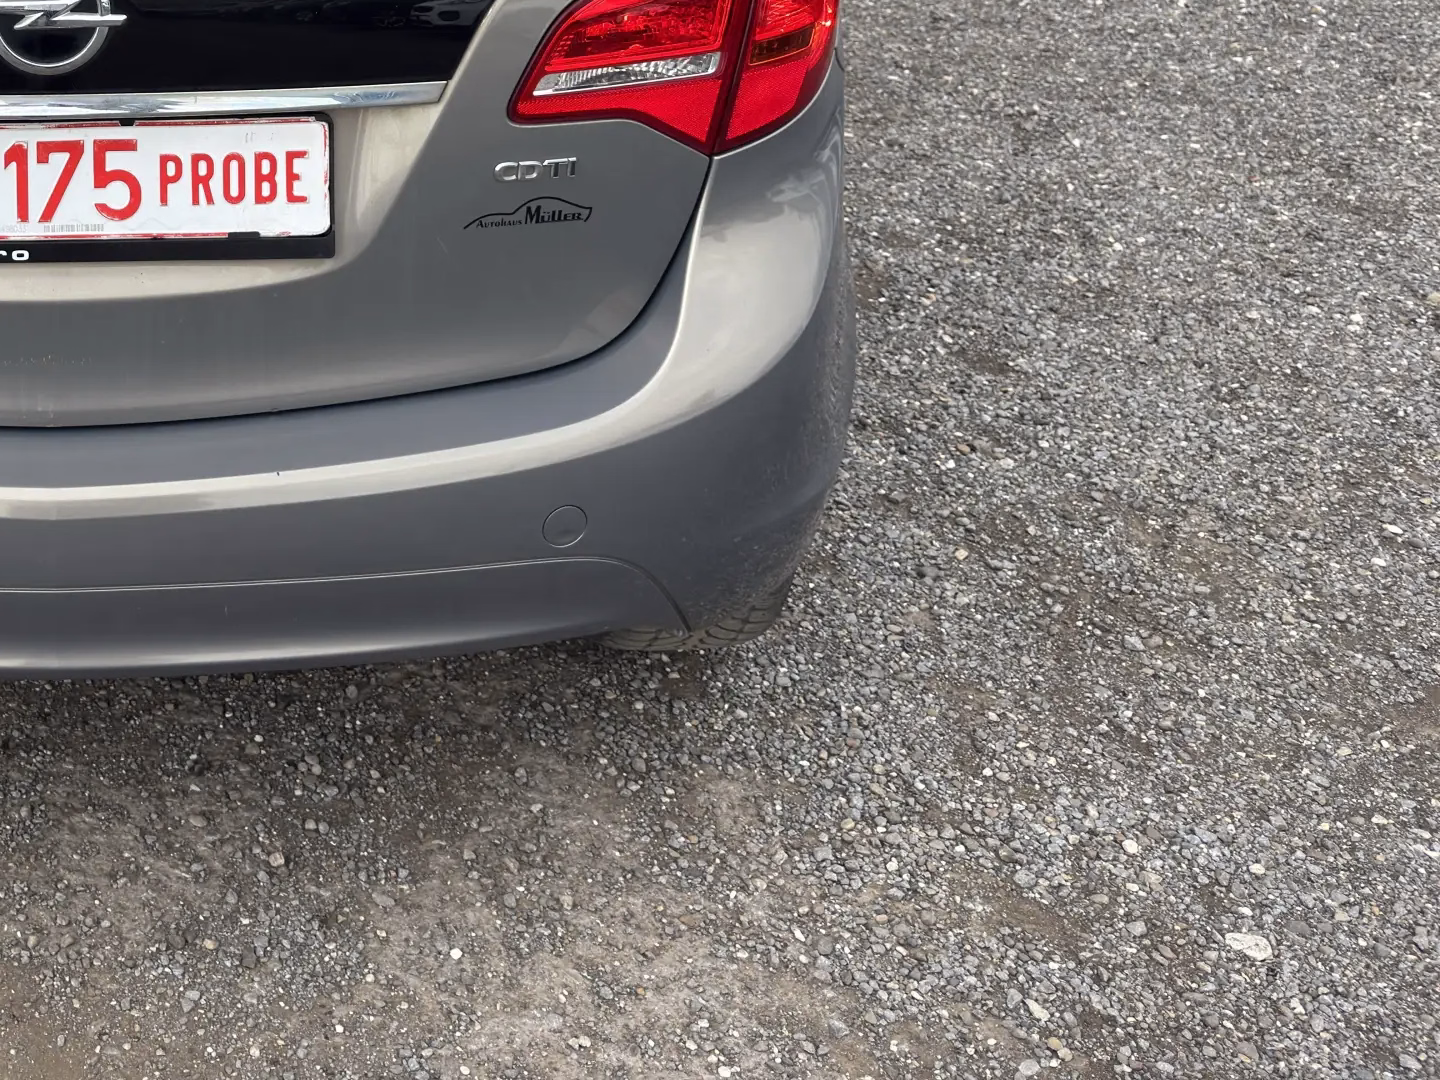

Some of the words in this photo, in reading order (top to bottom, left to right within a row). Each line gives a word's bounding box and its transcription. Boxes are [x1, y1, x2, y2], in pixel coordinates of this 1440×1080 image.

[4, 139, 142, 224] 175
[159, 150, 309, 207] PROBE
[493, 156, 577, 183] CDTI
